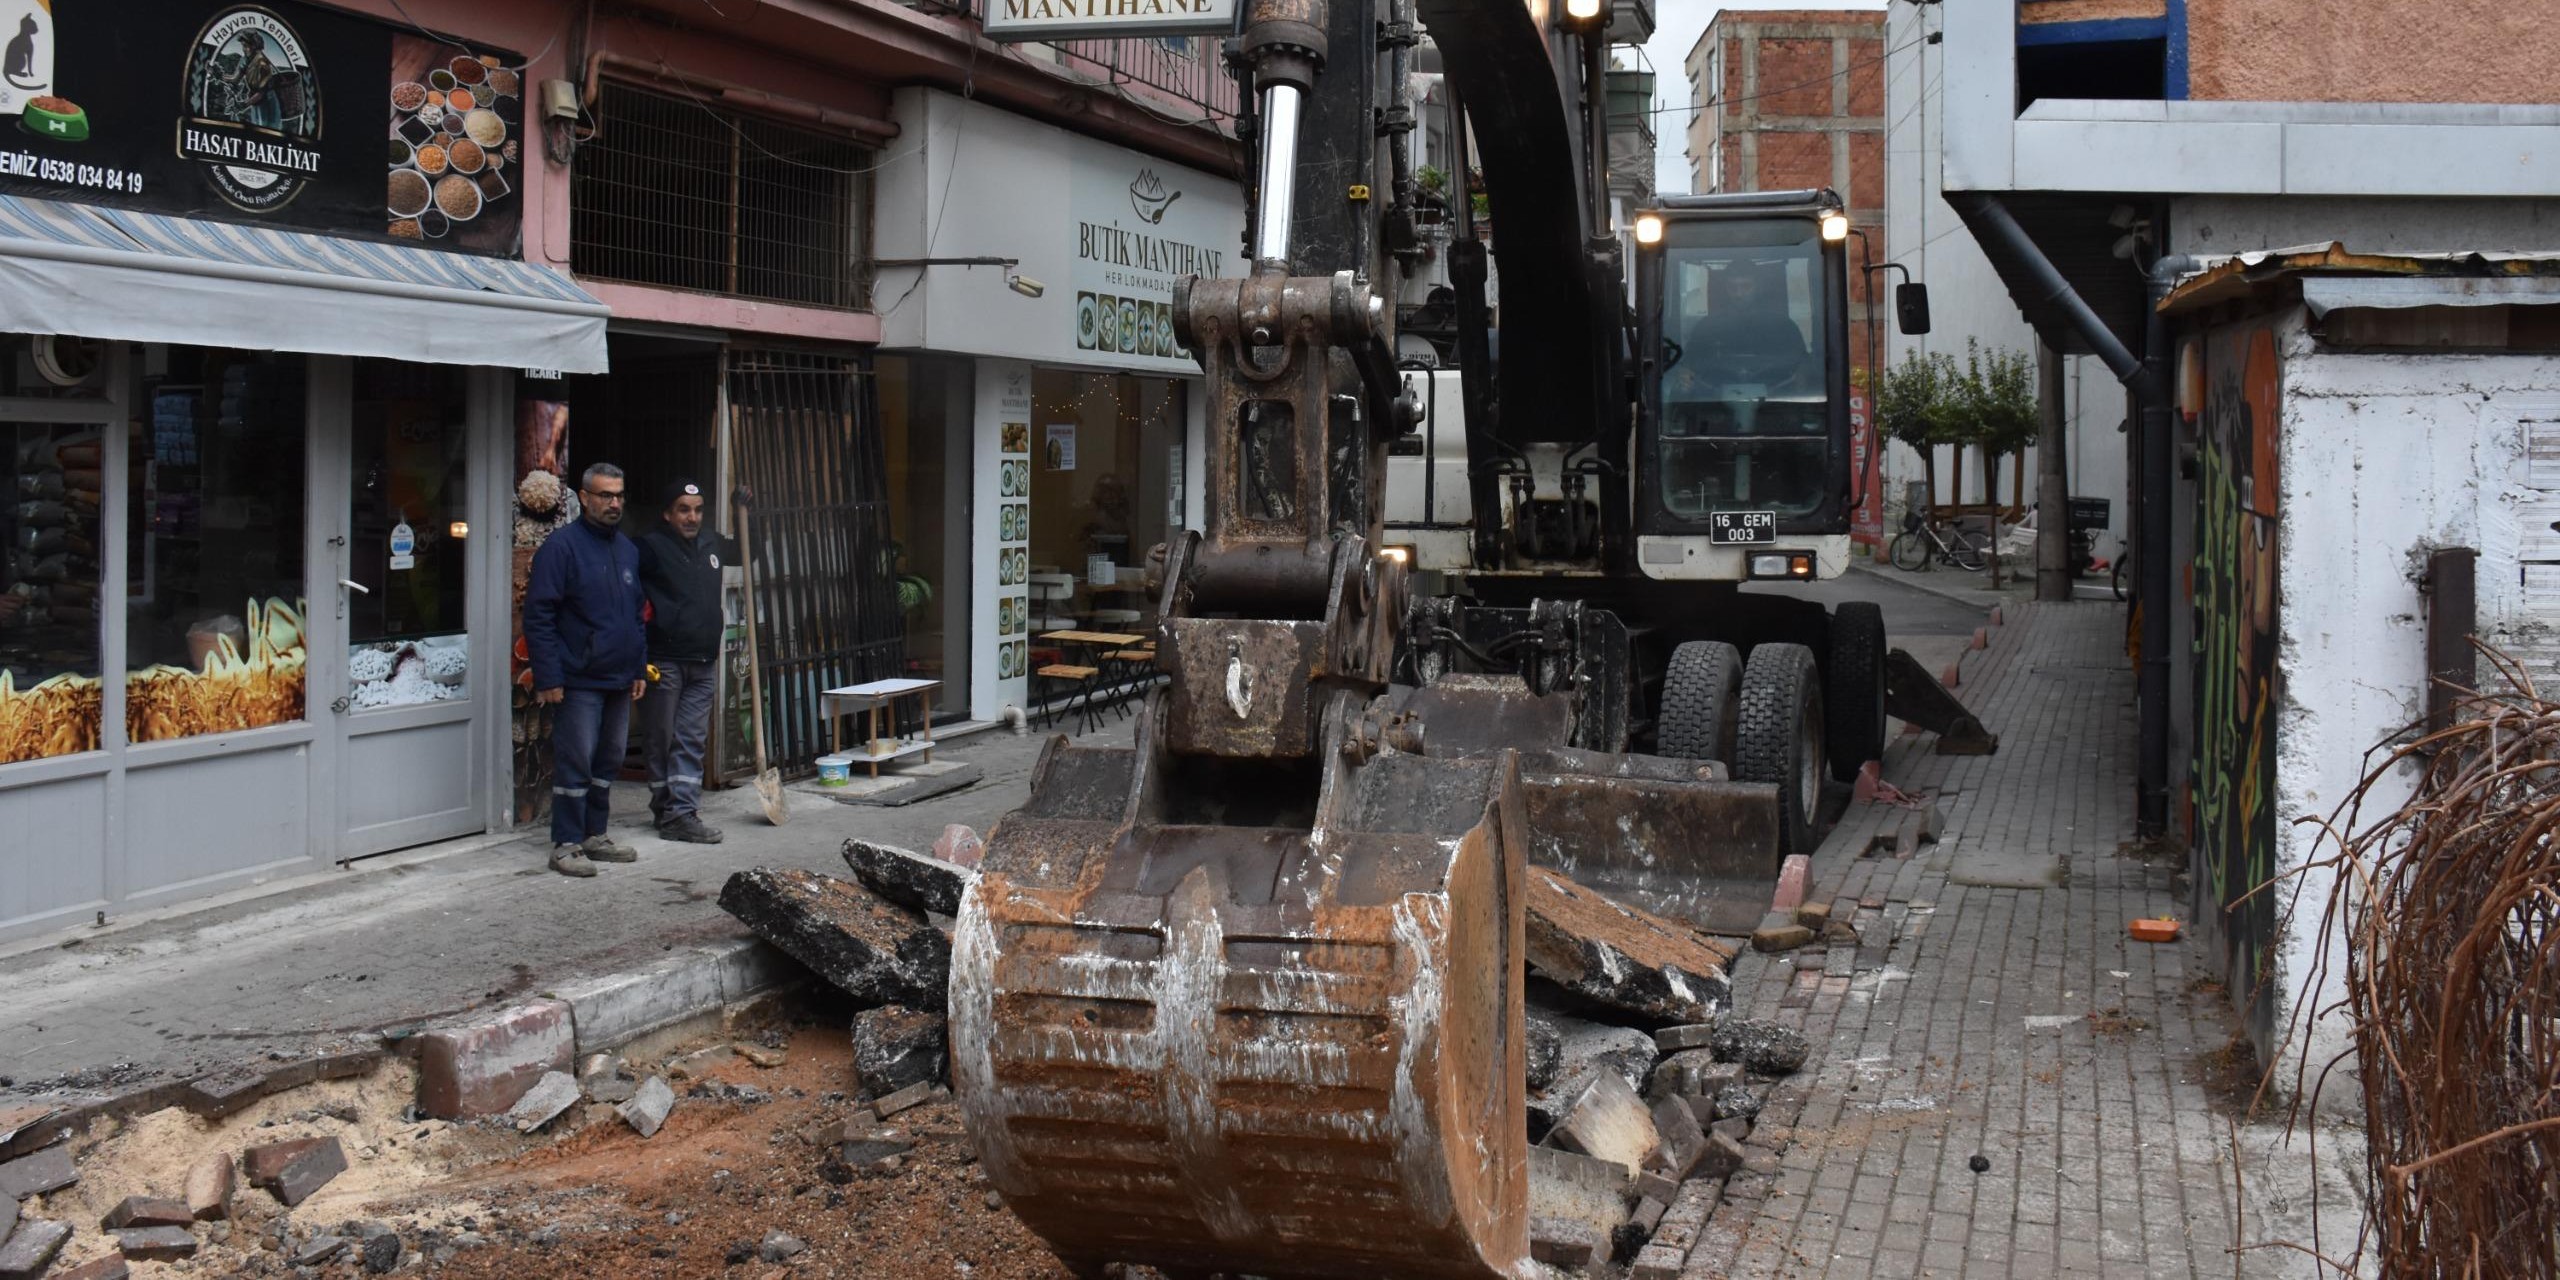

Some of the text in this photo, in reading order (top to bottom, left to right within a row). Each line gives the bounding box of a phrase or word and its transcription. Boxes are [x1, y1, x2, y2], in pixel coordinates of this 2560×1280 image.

[212, 15, 302, 63] Hayvan Yemleri
[185, 129, 321, 173] HASAT BAKLİYAT
[40, 158, 75, 183] 0538
[78, 164, 103, 188] 034
[106, 169, 123, 191] 84
[126, 172, 143, 194] 19
[1079, 219, 1223, 280] BUTİK MANTIHANE
[1105, 270, 1122, 285] HER
[1124, 273, 1165, 292] LOKMADA
[1716, 514, 1771, 528] 16 GEM
[1728, 528, 1755, 542] 003
